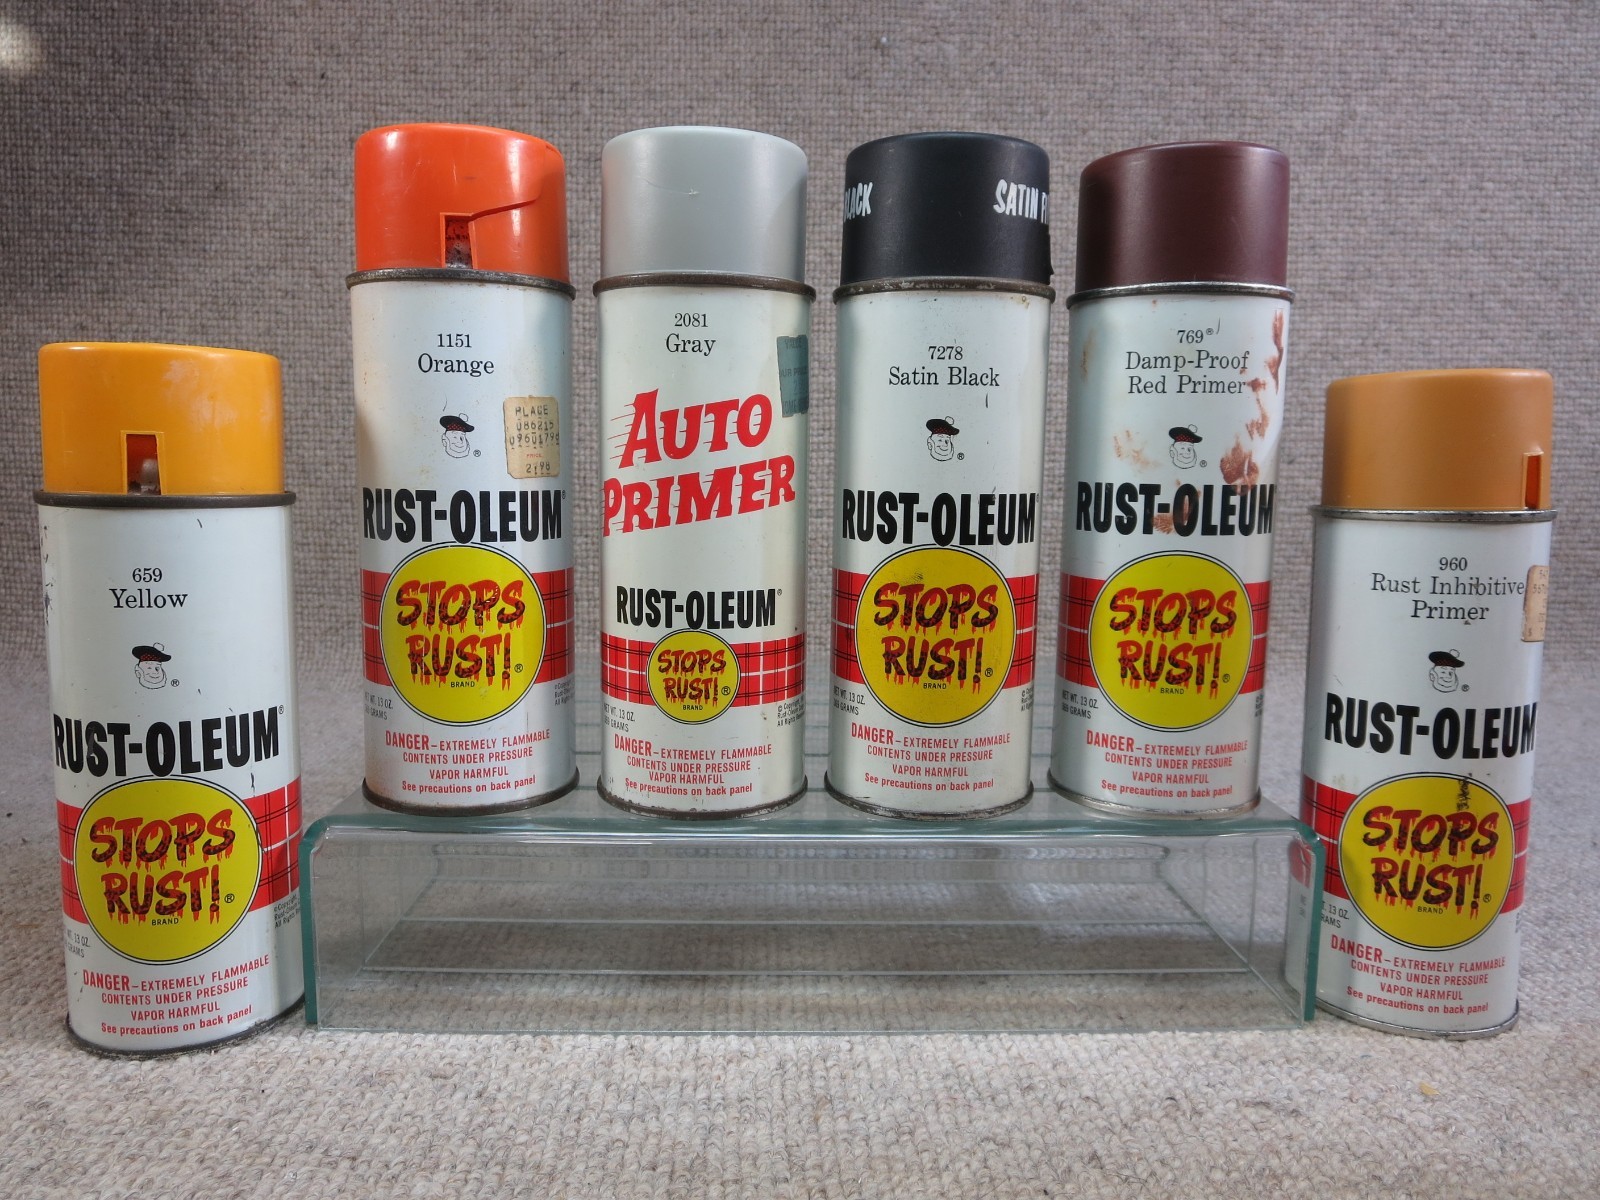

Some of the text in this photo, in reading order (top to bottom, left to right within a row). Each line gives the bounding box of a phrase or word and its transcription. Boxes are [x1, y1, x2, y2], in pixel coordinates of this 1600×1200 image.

[844, 182, 873, 222] LACK
[993, 179, 1039, 220] SATIN
[674, 312, 709, 328] 2081
[437, 333, 472, 348] 1151
[665, 333, 716, 356] Gray
[1177, 329, 1204, 344] 769
[928, 345, 963, 361] 7278
[1125, 350, 1250, 373] Damp-Proof
[418, 353, 495, 378] Orange
[889, 366, 1000, 387] Satin Black
[1128, 374, 1246, 395] Red Primer
[618, 388, 773, 469] AUTO
[602, 455, 796, 537] PRIMER
[362, 487, 562, 544] RUST-OLEUM
[843, 488, 1036, 547] RUST-OLEUM
[1076, 481, 1275, 537] RUST-OLEUM
[1439, 557, 1468, 571] 960
[132, 567, 163, 583] 659
[1371, 573, 1421, 594] Rust
[1429, 575, 1525, 596] Inhibitive
[109, 588, 188, 609] Yellow
[395, 579, 526, 632] STOPS
[616, 585, 776, 630] RUST-OLEUM
[874, 582, 999, 634] STOPS
[1109, 587, 1238, 640] STOPS
[1410, 599, 1490, 620] Primer
[405, 632, 511, 690] RUST!
[657, 649, 727, 676] STOPS
[881, 635, 984, 694] RUST!
[1117, 640, 1222, 699] RUST!
[662, 677, 719, 707] RUST!
[849, 692, 855, 702] 13
[1080, 696, 1087, 707] 13
[619, 708, 625, 720] 13
[1070, 706, 1092, 719] GRAMS
[1325, 692, 1537, 760] RUST-OLEUM
[53, 706, 279, 777] RUST-OLEUM
[502, 728, 550, 749] FLAMMABLE
[964, 733, 1011, 749] FLAMMABLE
[1205, 740, 1248, 755] FLAMMABLE
[403, 746, 533, 765] CONTENTS UNDER PRESSURE
[721, 743, 772, 760] FLAMMABLE
[867, 745, 993, 762] CONTENTS UNDER PRESSURE
[1105, 752, 1233, 769] CONTENTS UNDER PRESSURE
[429, 766, 509, 780] VAPOR HARMFUL
[627, 757, 751, 773] CONTENTS UNDER PRESSURE
[892, 764, 969, 777] VAPOR HARMFUL
[402, 774, 536, 794] See precautions on back panel
[625, 777, 753, 797] See precautions on back panel
[649, 771, 724, 784] VAPOR HARMFUL
[865, 773, 994, 792] See precautions on back panel
[1132, 771, 1209, 784] VAPOR HARMFUL
[1101, 780, 1233, 798] See precautions on back panel
[89, 809, 235, 869] STOPS
[1362, 805, 1499, 862] STOPS
[101, 865, 220, 924] RUST!
[1371, 857, 1483, 920] RUST!
[1329, 903, 1337, 915] 13
[1417, 906, 1444, 915] BRAND
[151, 918, 179, 926] BRAND
[1320, 912, 1341, 928] RAMS
[211, 954, 270, 983] FLAMMABLE
[1351, 960, 1489, 986] CONTENTS UNDER PRESSURE
[1459, 956, 1506, 972] FLAMMABLE
[101, 977, 249, 1006] CONTENTS UNDER PRESSURE
[1347, 986, 1489, 1015] See precautions on back panel
[1380, 982, 1463, 1001] VAPOR HARMFUL
[101, 1004, 252, 1037] See precautions on back panel
[131, 1001, 221, 1022] VAPOR HARMFUL
